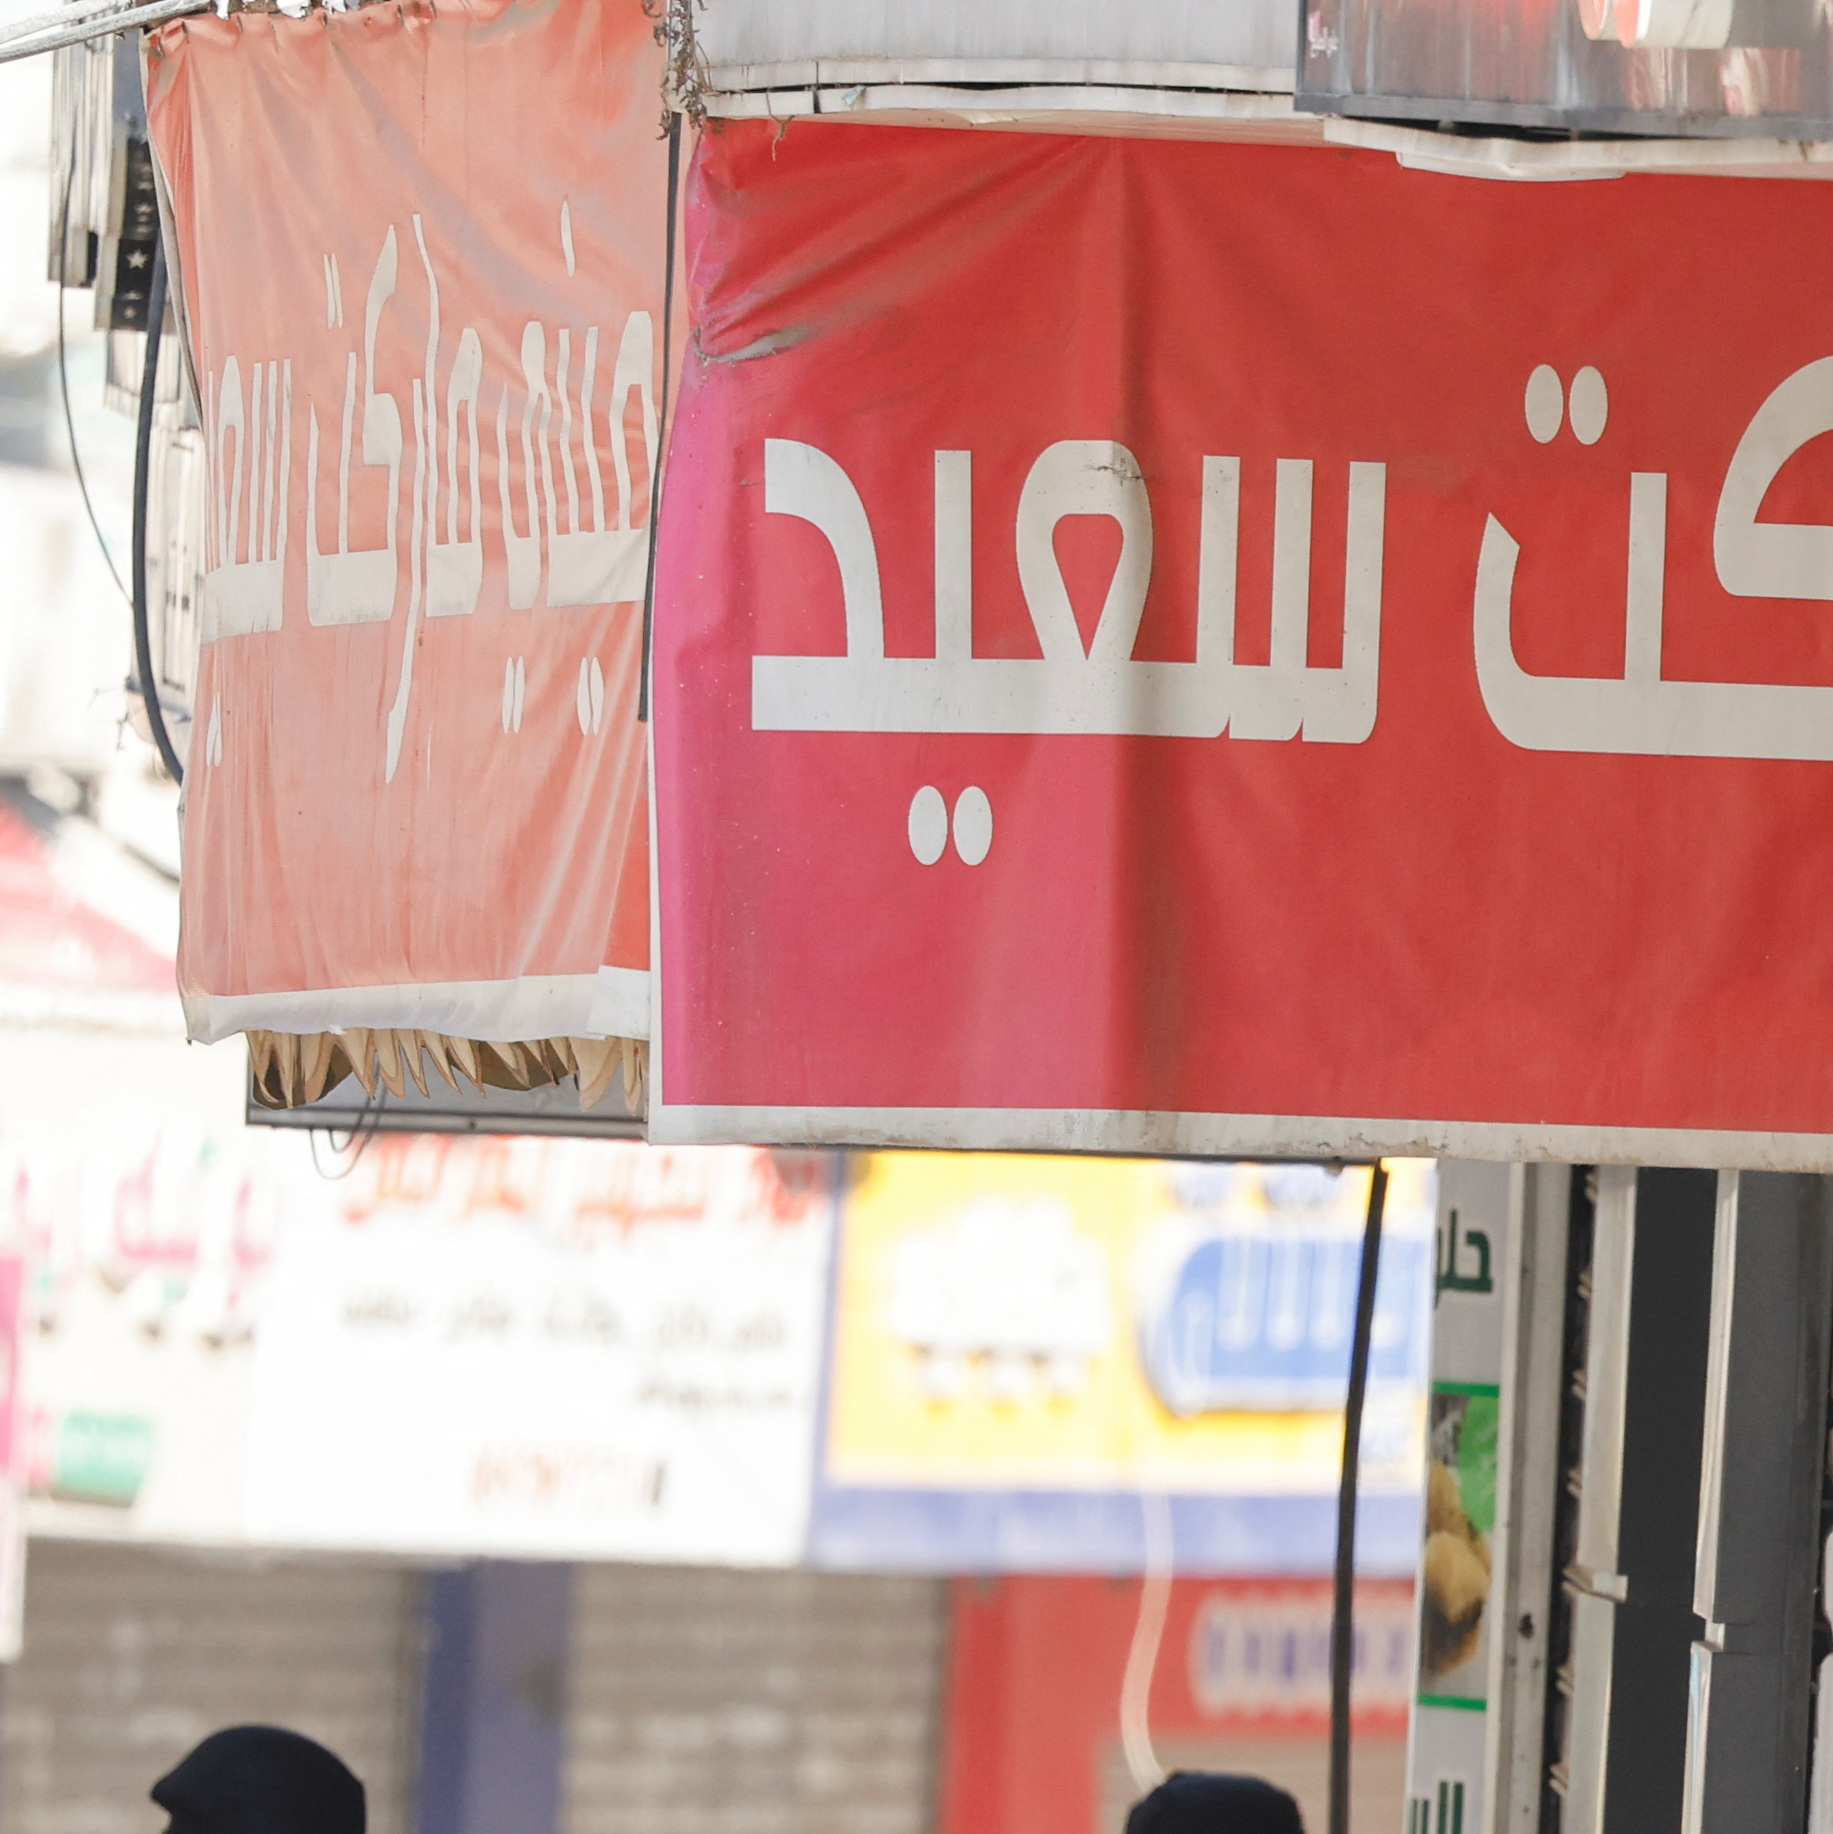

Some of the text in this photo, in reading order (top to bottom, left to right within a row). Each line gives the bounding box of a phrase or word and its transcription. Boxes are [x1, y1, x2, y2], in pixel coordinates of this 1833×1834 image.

[199, 199, 660, 785] ميني ماركت سعي
[750, 437, 1386, 867] سعيد
